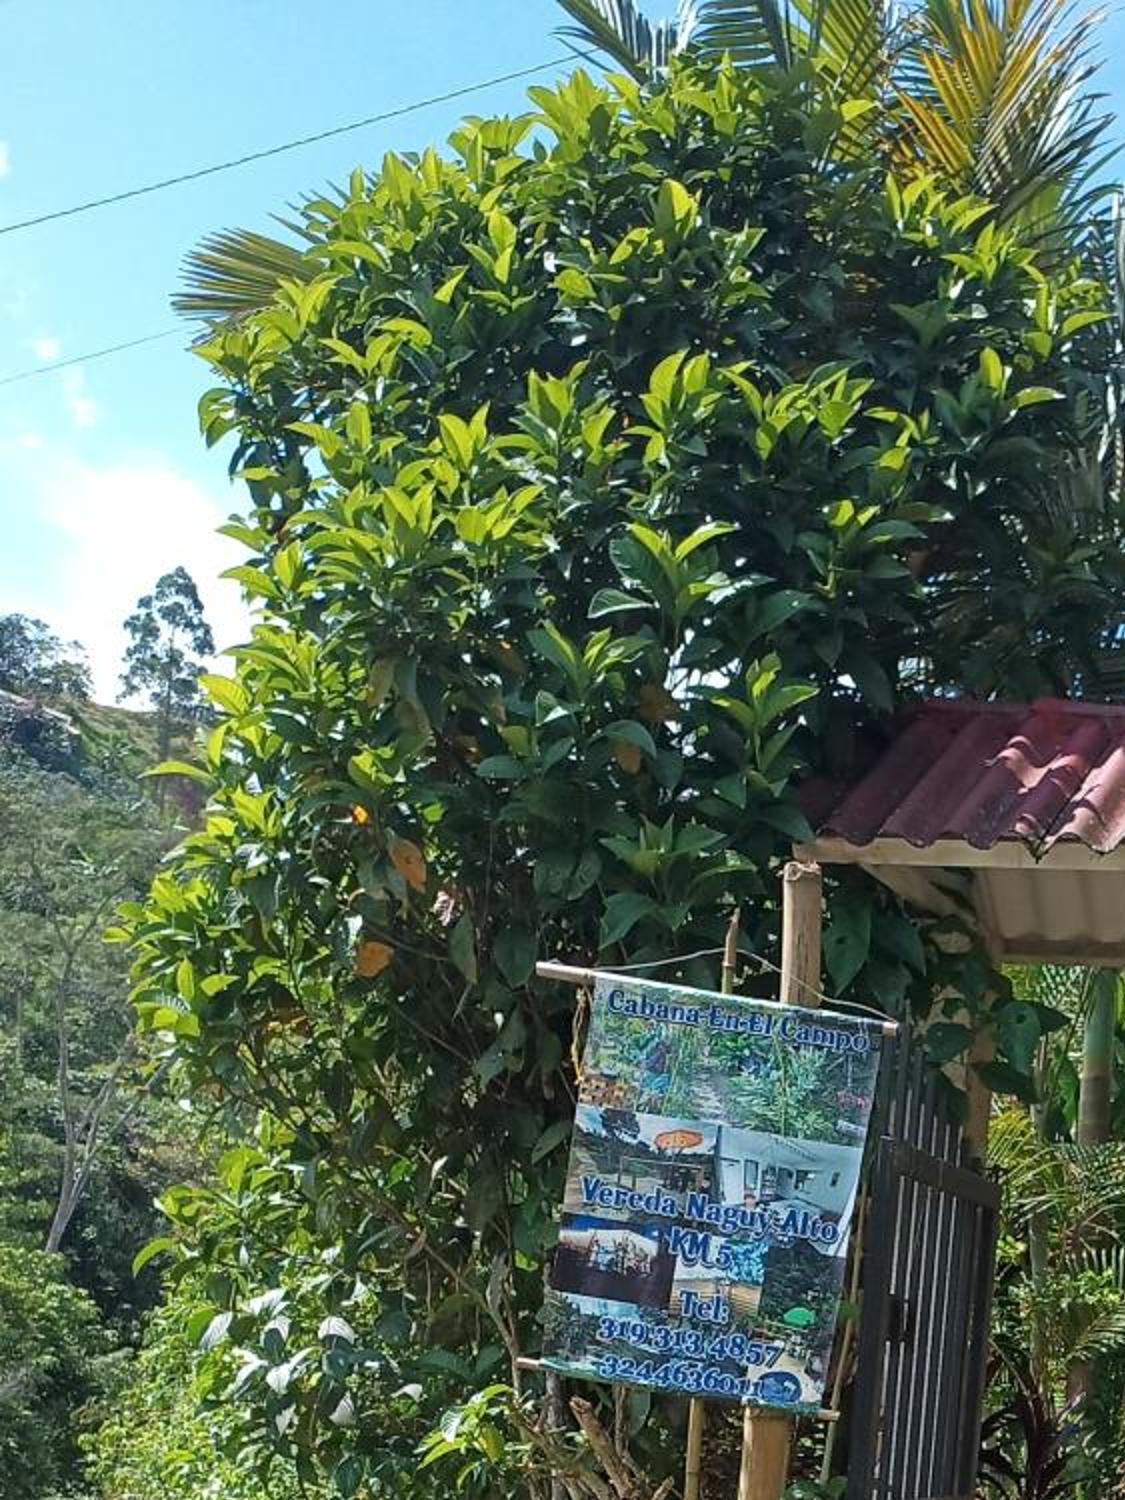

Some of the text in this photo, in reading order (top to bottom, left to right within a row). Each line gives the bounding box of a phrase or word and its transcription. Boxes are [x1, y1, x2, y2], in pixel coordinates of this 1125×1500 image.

[780, 1012, 869, 1052] Campo
[580, 1177, 840, 1243] Vereda Naguy Alto
[669, 1225, 734, 1270] KM 5
[680, 1289, 730, 1323] Tel:
[598, 1315, 784, 1368] 319 313 4857
